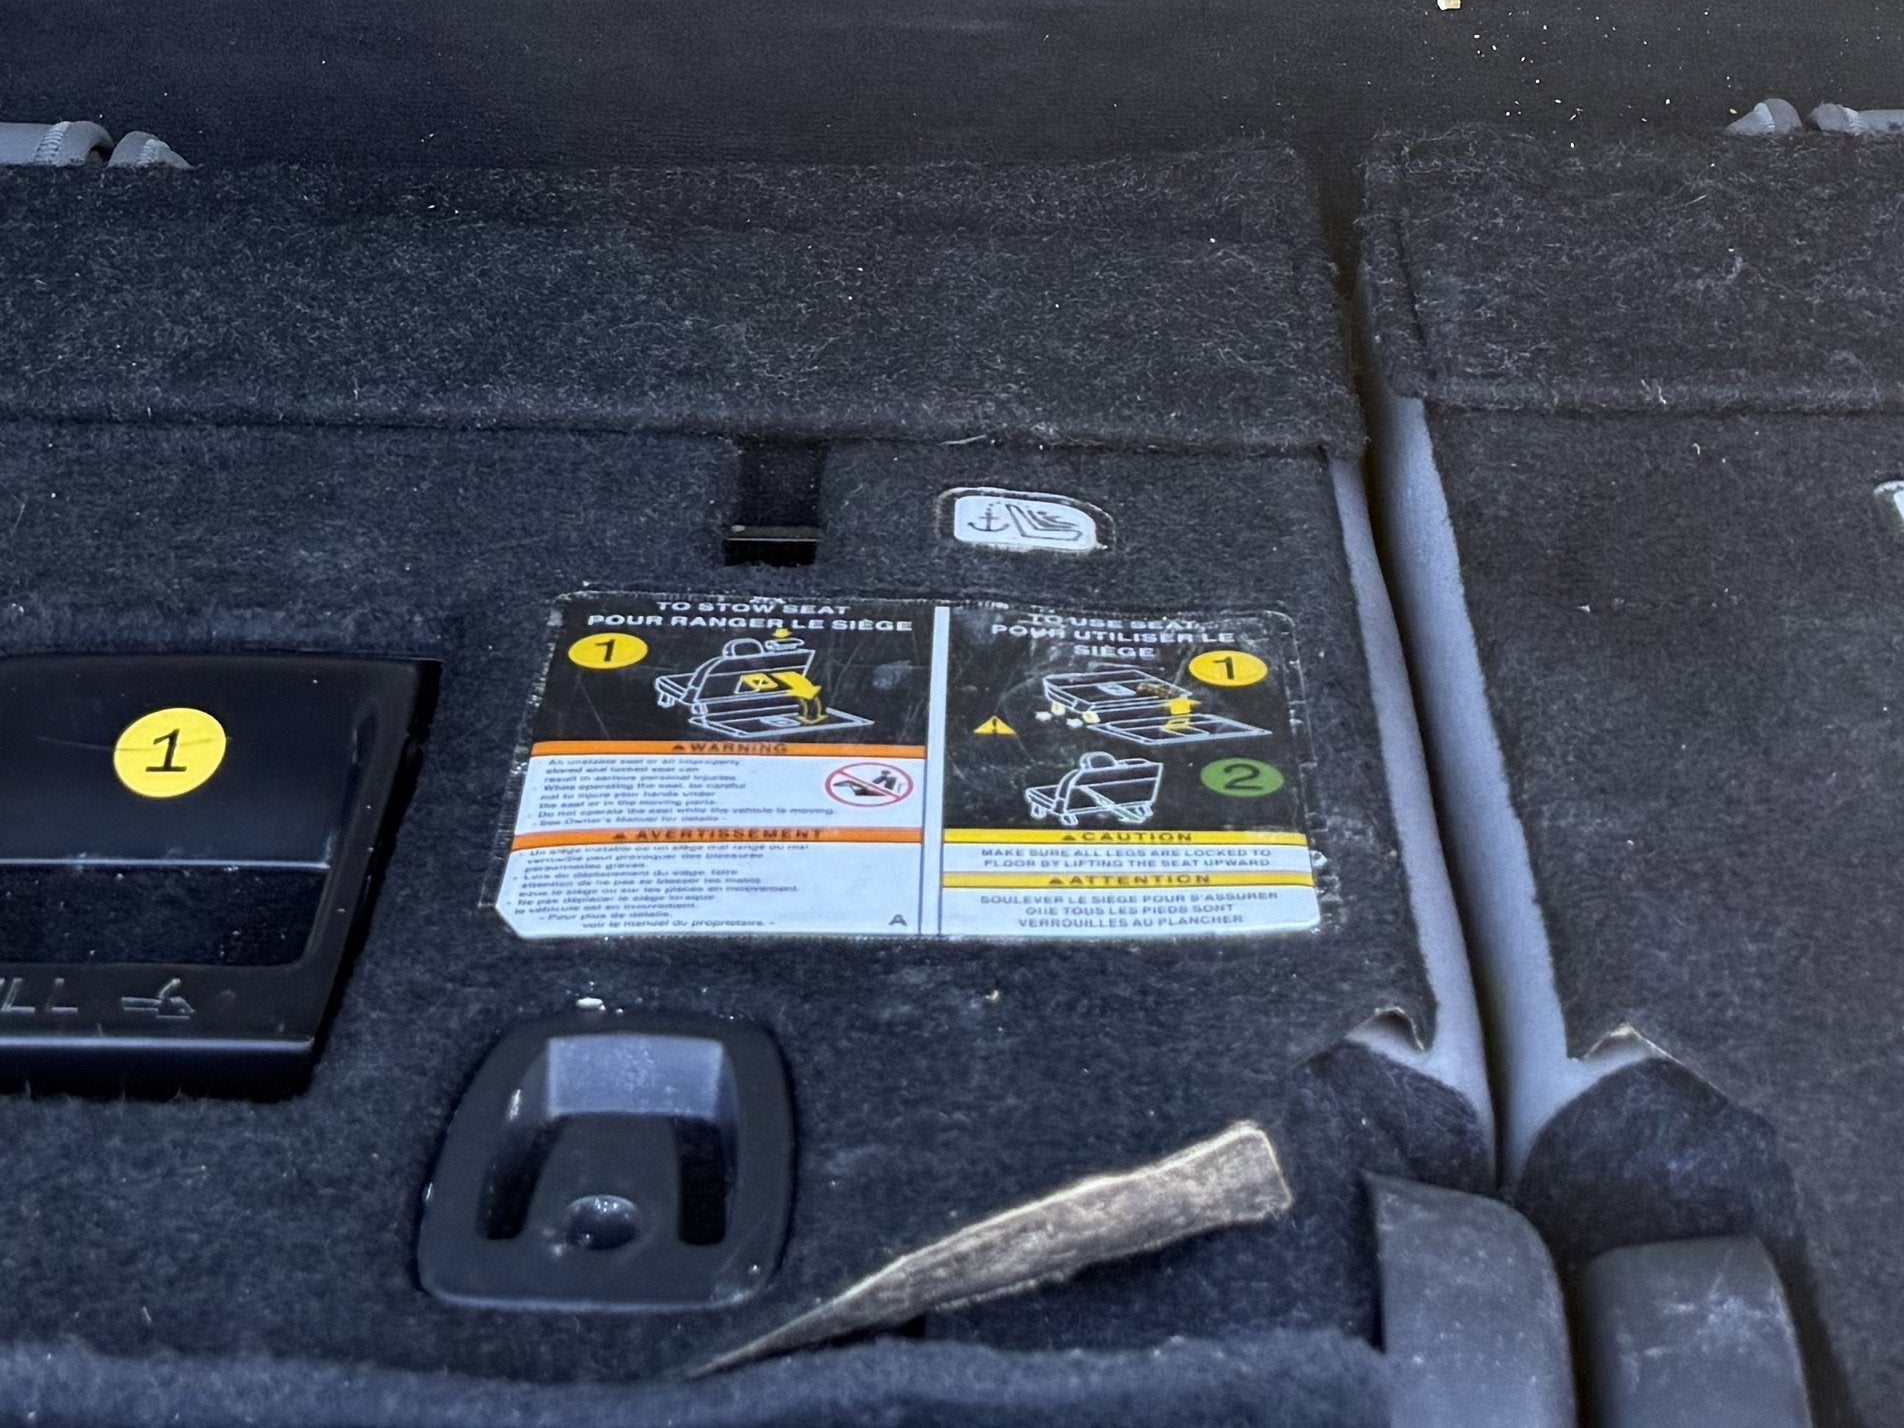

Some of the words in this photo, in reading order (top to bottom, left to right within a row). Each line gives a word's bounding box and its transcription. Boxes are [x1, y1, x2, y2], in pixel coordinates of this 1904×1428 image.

[656, 602, 691, 612] TO
[698, 603, 775, 614] STOW
[782, 605, 851, 615] SEAT
[587, 615, 664, 626] POUR
[671, 616, 784, 628] RANGER
[792, 619, 824, 629] LE
[831, 619, 913, 631] SIÈGE
[1073, 618, 1122, 629] USE
[1130, 620, 1196, 630] SEAT
[991, 624, 1065, 638] POUR
[1074, 630, 1194, 643] UTILISER
[1202, 633, 1235, 643] LE
[595, 639, 615, 663] 1
[1074, 644, 1157, 658] SIÈGE
[1213, 657, 1235, 680] 1
[145, 728, 187, 772] 1
[689, 742, 787, 753] WARNING
[1223, 764, 1264, 791] 2
[635, 829, 821, 840] AVERTISSEMENT
[1081, 832, 1192, 841] CAUTION
[981, 849, 1025, 857] MAKE
[1028, 849, 1070, 857] SURE
[1074, 849, 1102, 857] ALL
[1106, 849, 1146, 857] LEGS
[1150, 849, 1180, 857] ARE
[1184, 849, 1248, 857] LOCKED
[1253, 849, 1272, 857] TO
[984, 859, 1036, 867] FLOOR
[1040, 859, 1059, 867] BY
[1063, 859, 1123, 867] LIFTING
[1127, 859, 1157, 867] THE
[1161, 859, 1200, 867] SEAT
[1069, 875, 1210, 885] ATTENTION
[980, 896, 1064, 904] SOULEVER
[1068, 896, 1087, 904] LE
[1091, 894, 1138, 904] SIÈGE
[1143, 895, 1185, 903] POUR
[1190, 892, 1278, 902] S'ASSURER
[1026, 907, 1059, 915] QUE
[1063, 906, 1105, 915] TOUS
[1109, 906, 1138, 915] LES
[1142, 905, 1188, 914] PIEDS
[1193, 903, 1234, 913] SONT
[889, 913, 907, 927] A
[1132, 919, 1153, 927] AU
[1158, 915, 1244, 927] PLANCHER
